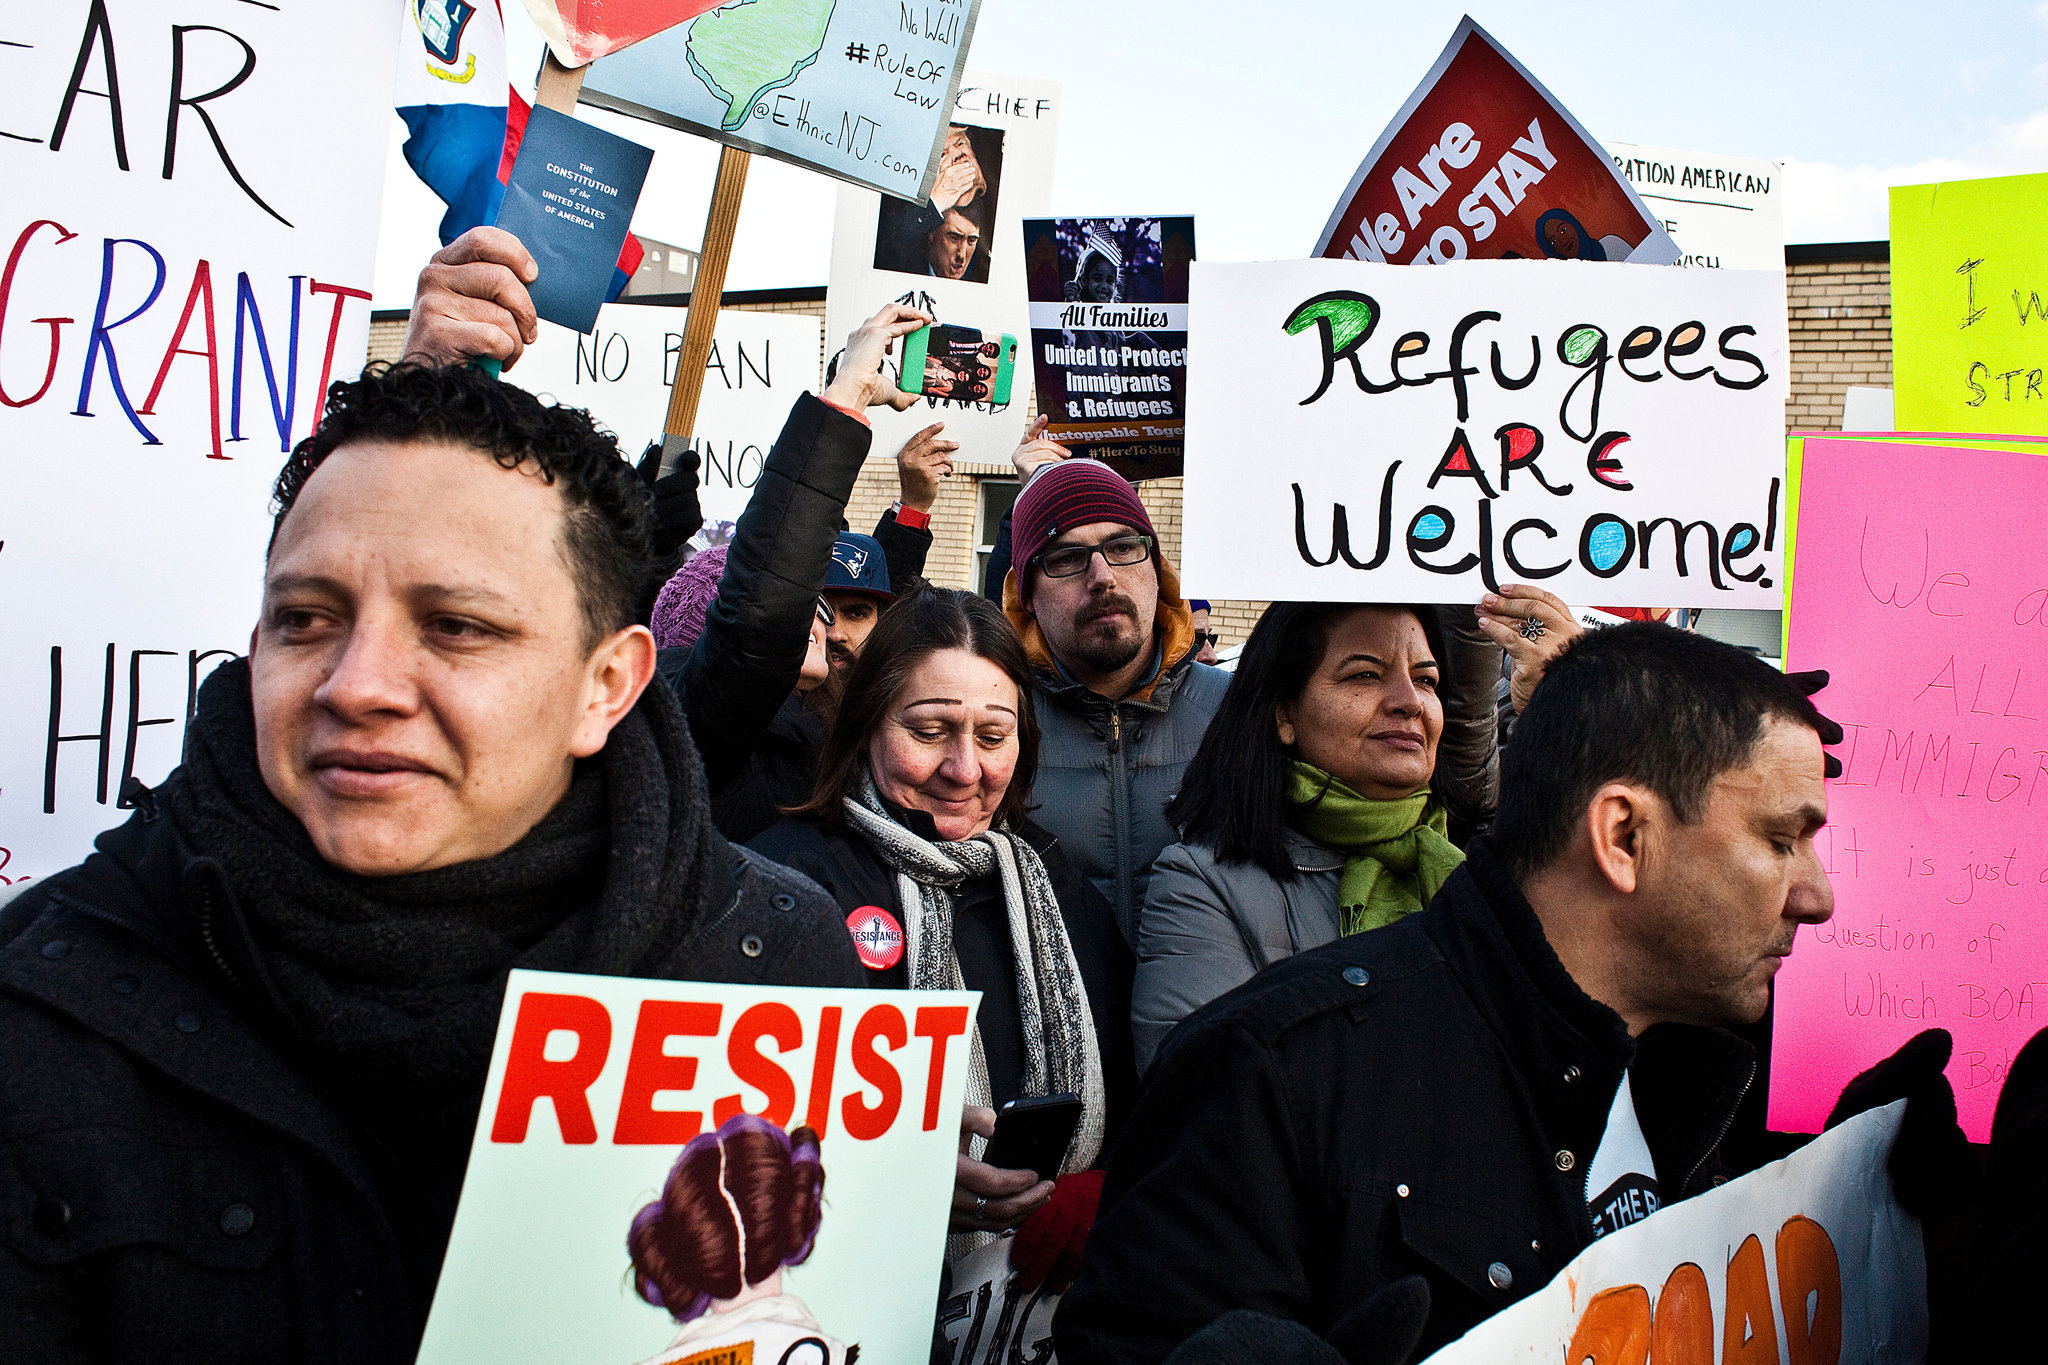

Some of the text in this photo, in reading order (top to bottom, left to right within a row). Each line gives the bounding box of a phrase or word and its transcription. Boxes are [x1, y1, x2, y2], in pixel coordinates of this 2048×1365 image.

[899, 2, 960, 48] No Wall
[894, 78, 940, 109] Law
[955, 87, 1051, 119] CHIEF
[752, 94, 918, 181] @EthnicNJ.com
[546, 162, 618, 197] CONSTITUTION
[579, 162, 594, 174] THE
[1391, 122, 1482, 231] Are
[1458, 117, 1558, 242] STAY
[1681, 165, 1770, 195] AMERICAN
[542, 189, 606, 220] UNITED STATES
[569, 187, 591, 200] of the
[545, 204, 595, 230] OF AMERICA
[1060, 304, 1169, 328] All Families
[1956, 257, 1988, 330] I
[576, 330, 630, 385] NO
[1044, 343, 1097, 367] United
[1100, 346, 1118, 367] to
[1282, 290, 1769, 442] Refugees
[1066, 371, 1172, 395] Immigrants
[1068, 398, 1174, 419] & Refugees
[1142, 425, 1184, 438] Toge
[1427, 422, 1634, 499] ARE
[1291, 460, 1780, 594] Welcome!
[1860, 515, 1970, 618] We
[1913, 655, 2039, 721] ALL
[1825, 824, 2020, 905] It is just
[1814, 914, 2006, 964] Question of
[1844, 972, 1937, 1020] Which
[490, 991, 969, 1145] RESIST
[1605, 1188, 1645, 1231] THE
